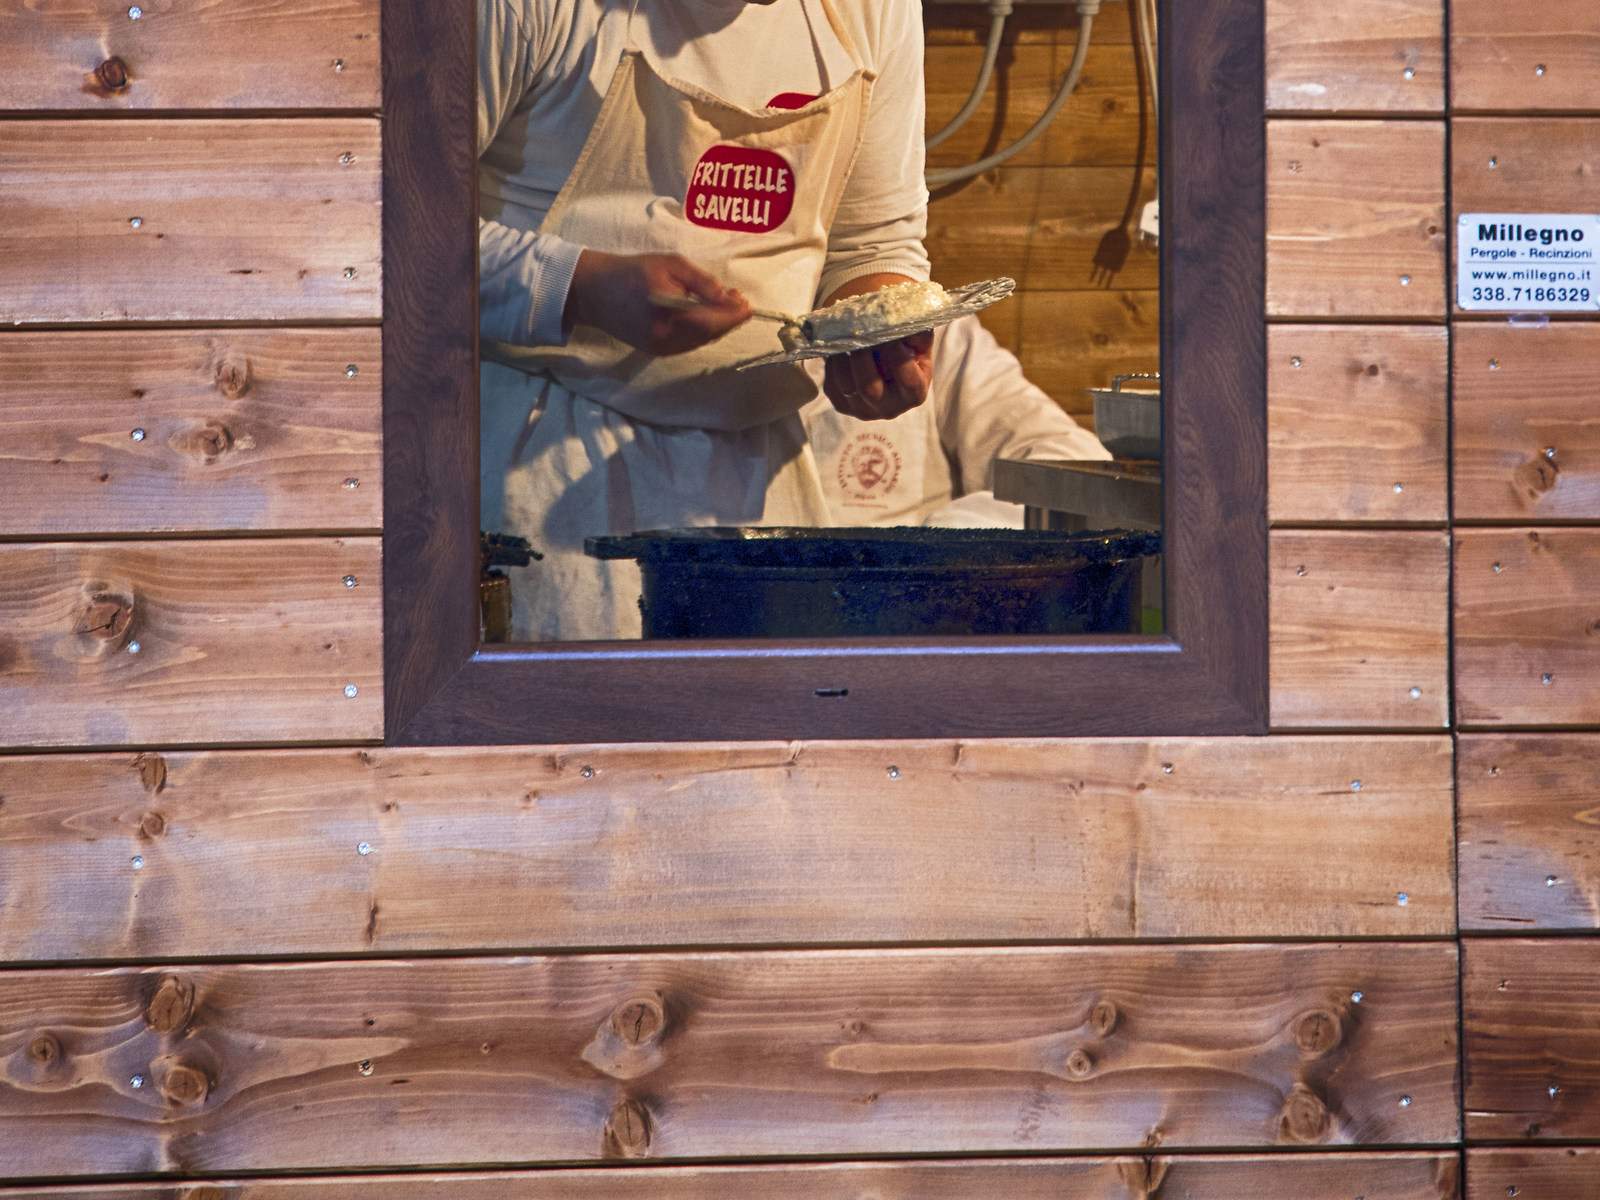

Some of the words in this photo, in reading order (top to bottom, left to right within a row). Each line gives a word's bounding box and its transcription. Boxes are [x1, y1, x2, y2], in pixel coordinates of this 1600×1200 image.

[693, 160, 789, 194] FRITTELLE
[693, 193, 771, 226] SAVELLI
[1478, 223, 1584, 245] Millegno
[1470, 247, 1517, 260] Pergole
[1529, 247, 1592, 259] Recinzioni
[1472, 269, 1591, 282] www.millegno.it
[1472, 287, 1590, 302] 338.7186329
